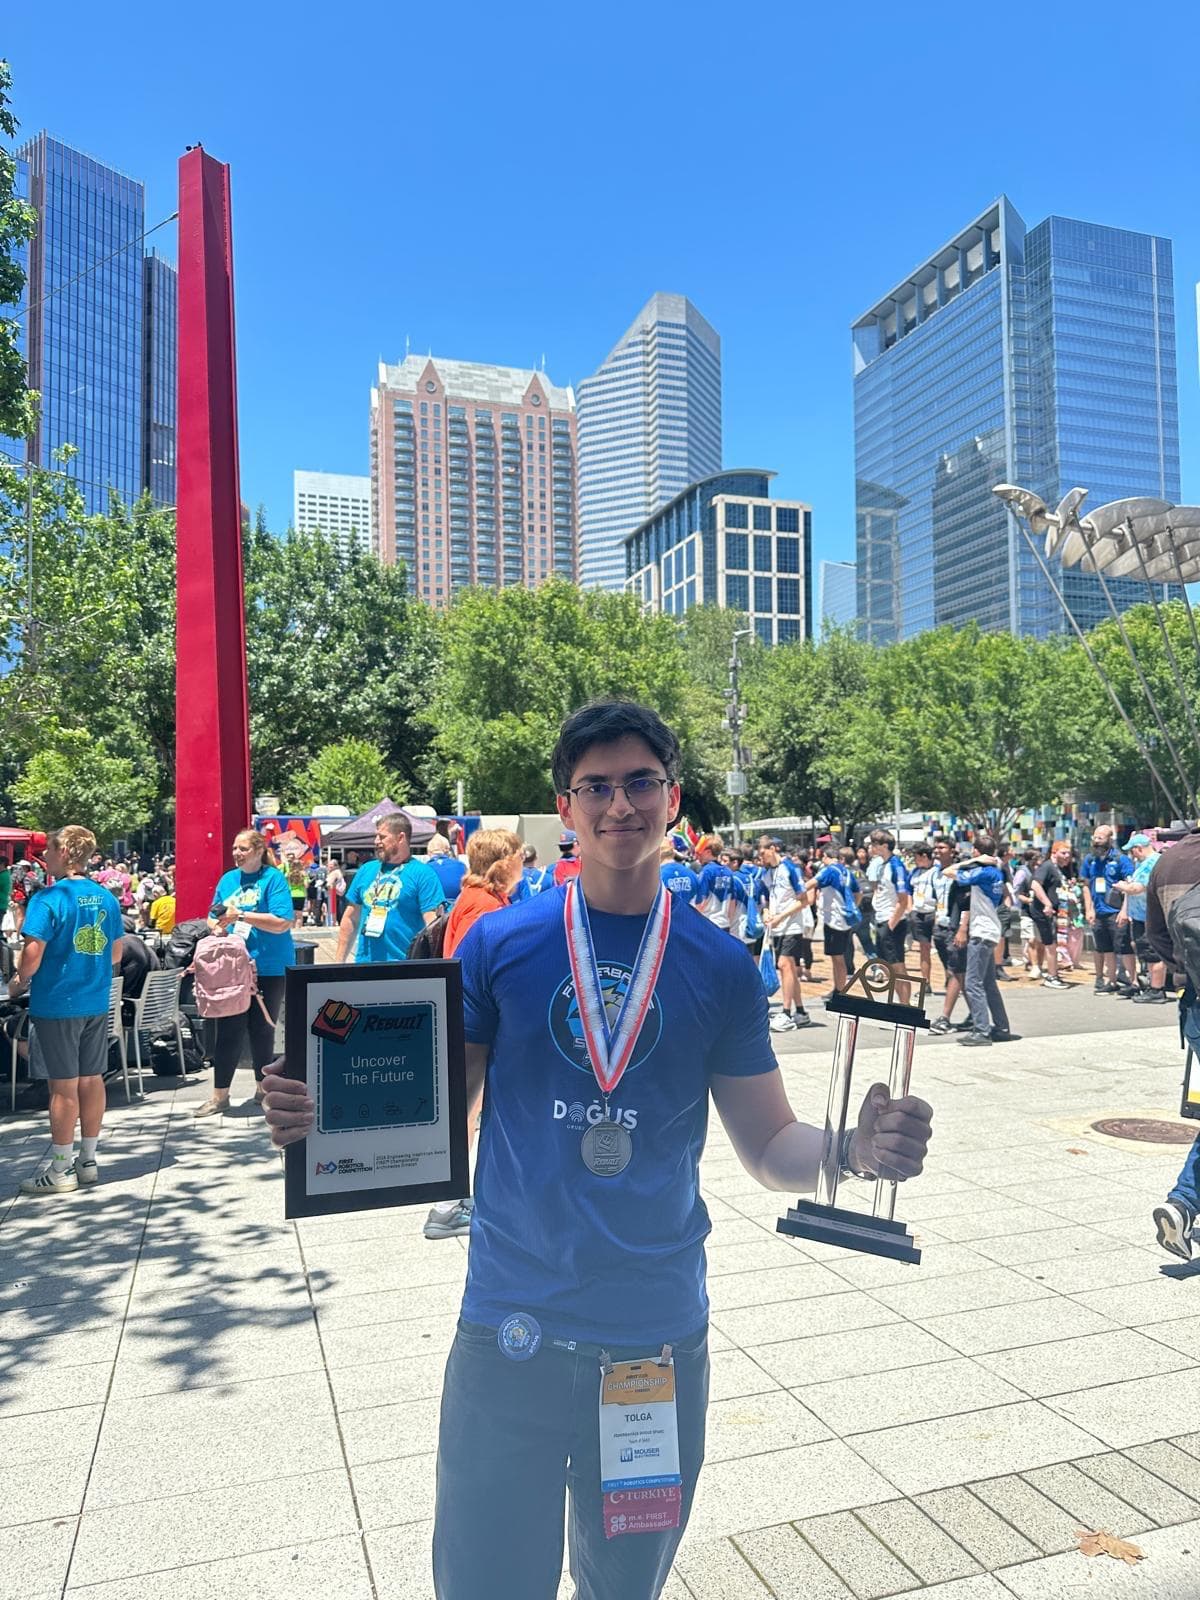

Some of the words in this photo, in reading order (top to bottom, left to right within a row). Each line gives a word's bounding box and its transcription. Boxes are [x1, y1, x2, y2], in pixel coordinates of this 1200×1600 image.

[351, 1055, 407, 1069] Uncover
[342, 1072, 368, 1086] The
[372, 1070, 415, 1084] Future
[608, 1377, 668, 1391] CHAMPIONSHIP
[624, 1412, 653, 1422] TOLGA
[646, 1511, 668, 1520] FIRST
[628, 1519, 673, 1529] Ambassador
